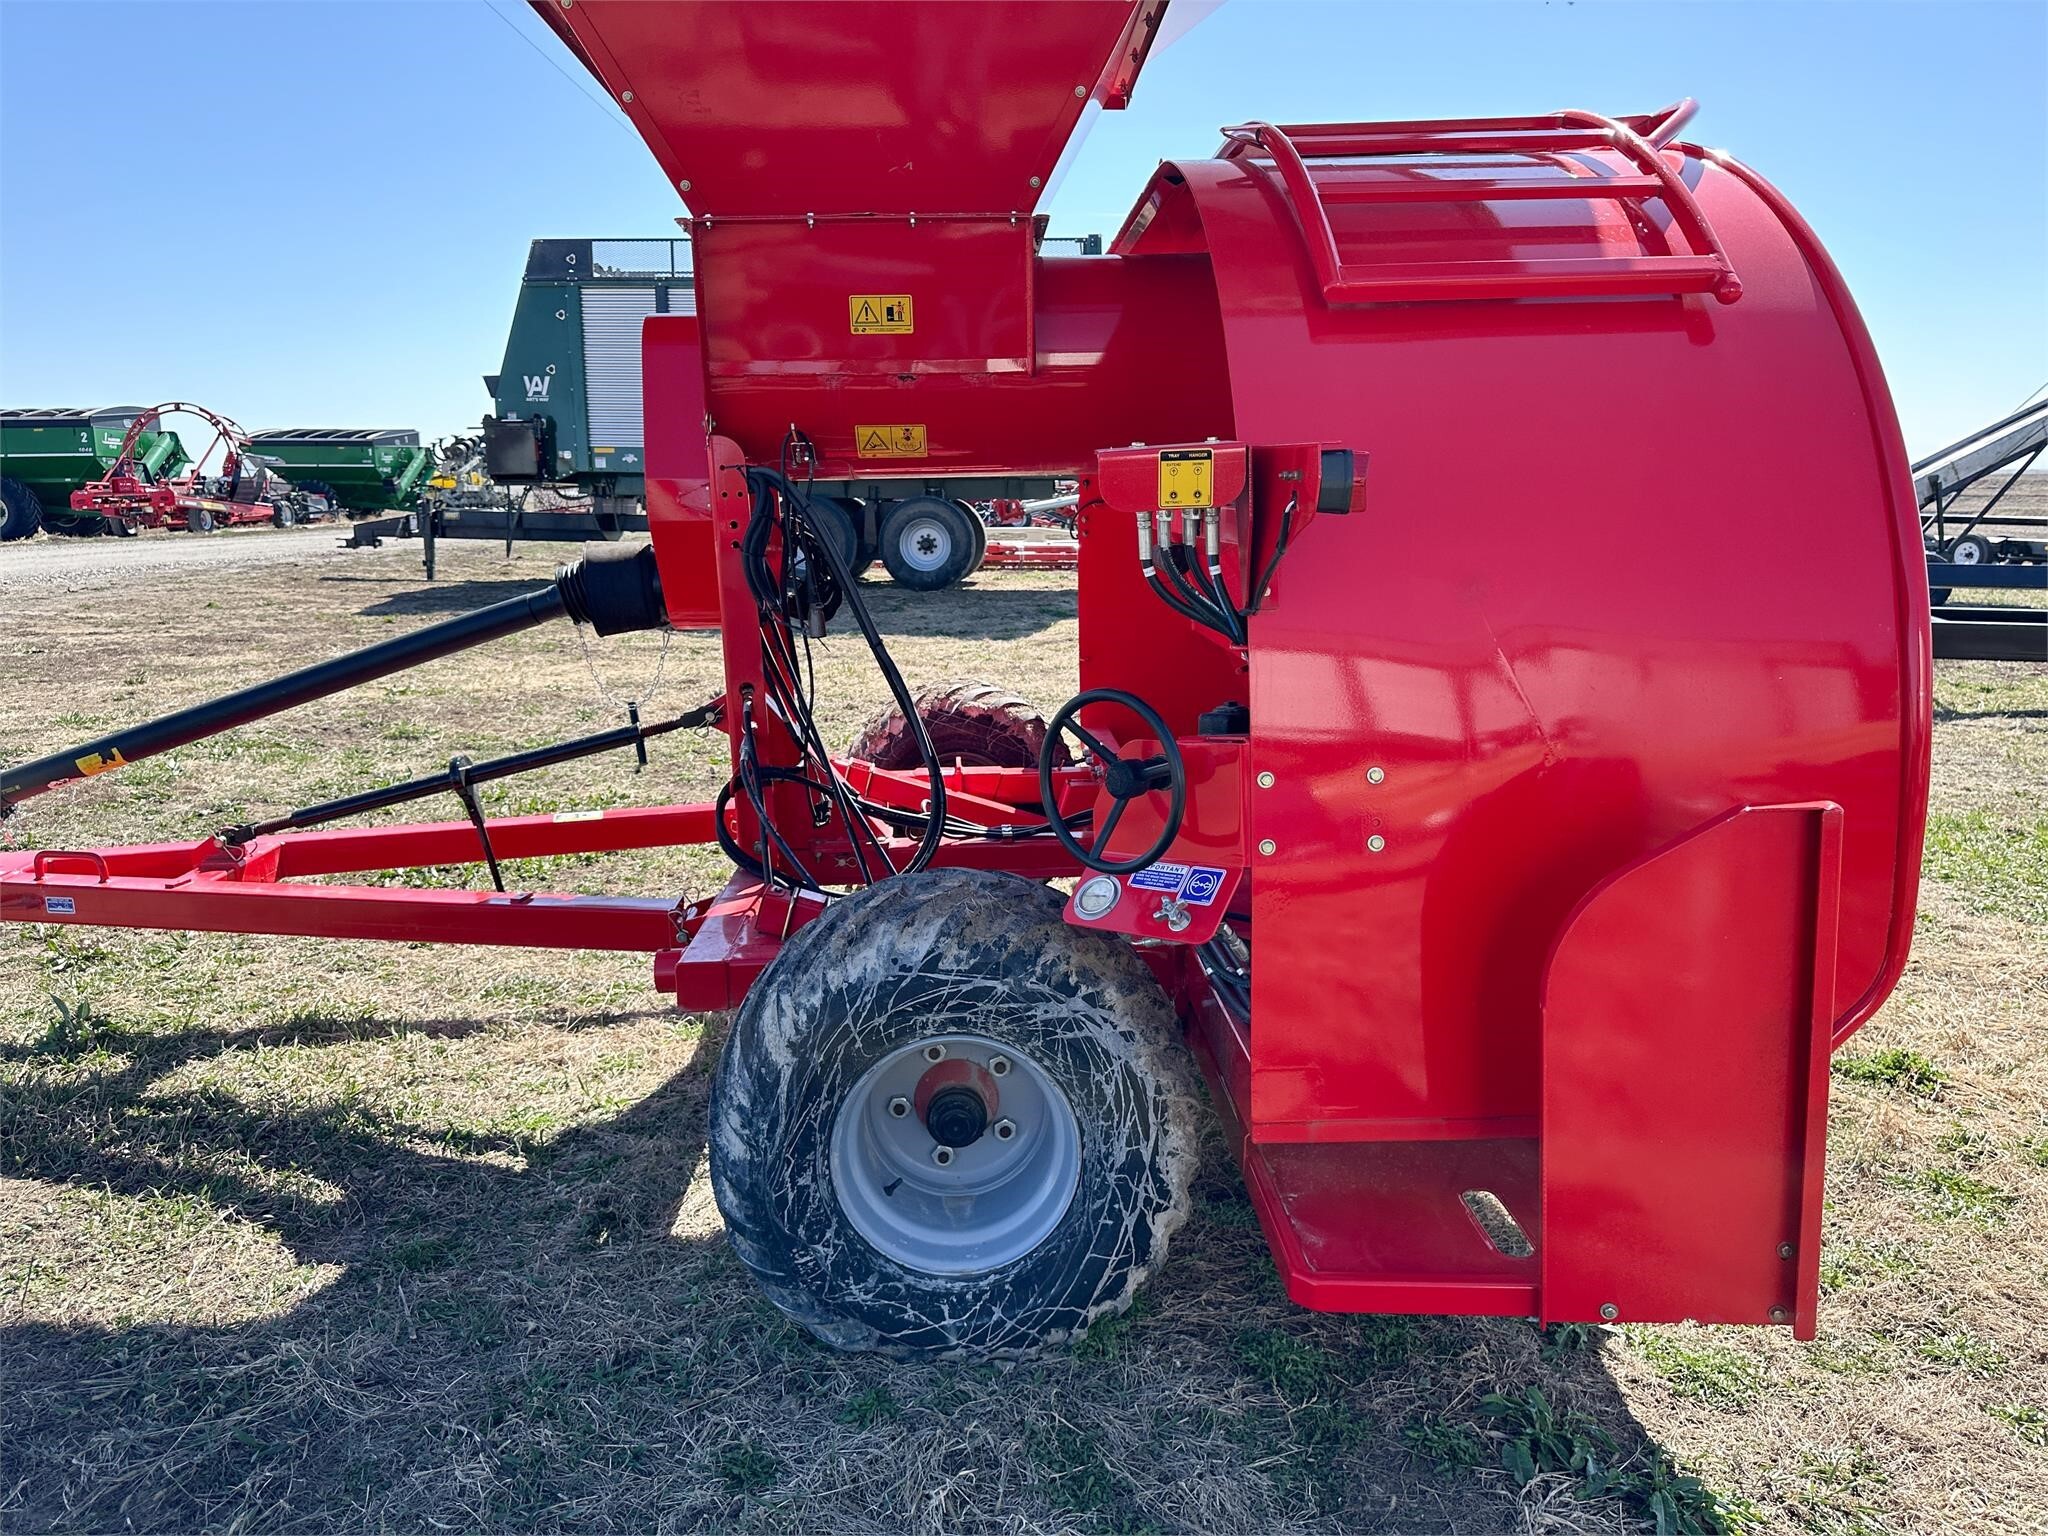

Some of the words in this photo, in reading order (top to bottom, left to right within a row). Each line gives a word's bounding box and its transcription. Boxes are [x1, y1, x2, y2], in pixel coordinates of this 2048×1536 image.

[80, 432, 88, 442] 2
[368, 448, 372, 456] 1
[1150, 864, 1184, 873] PORTANT
